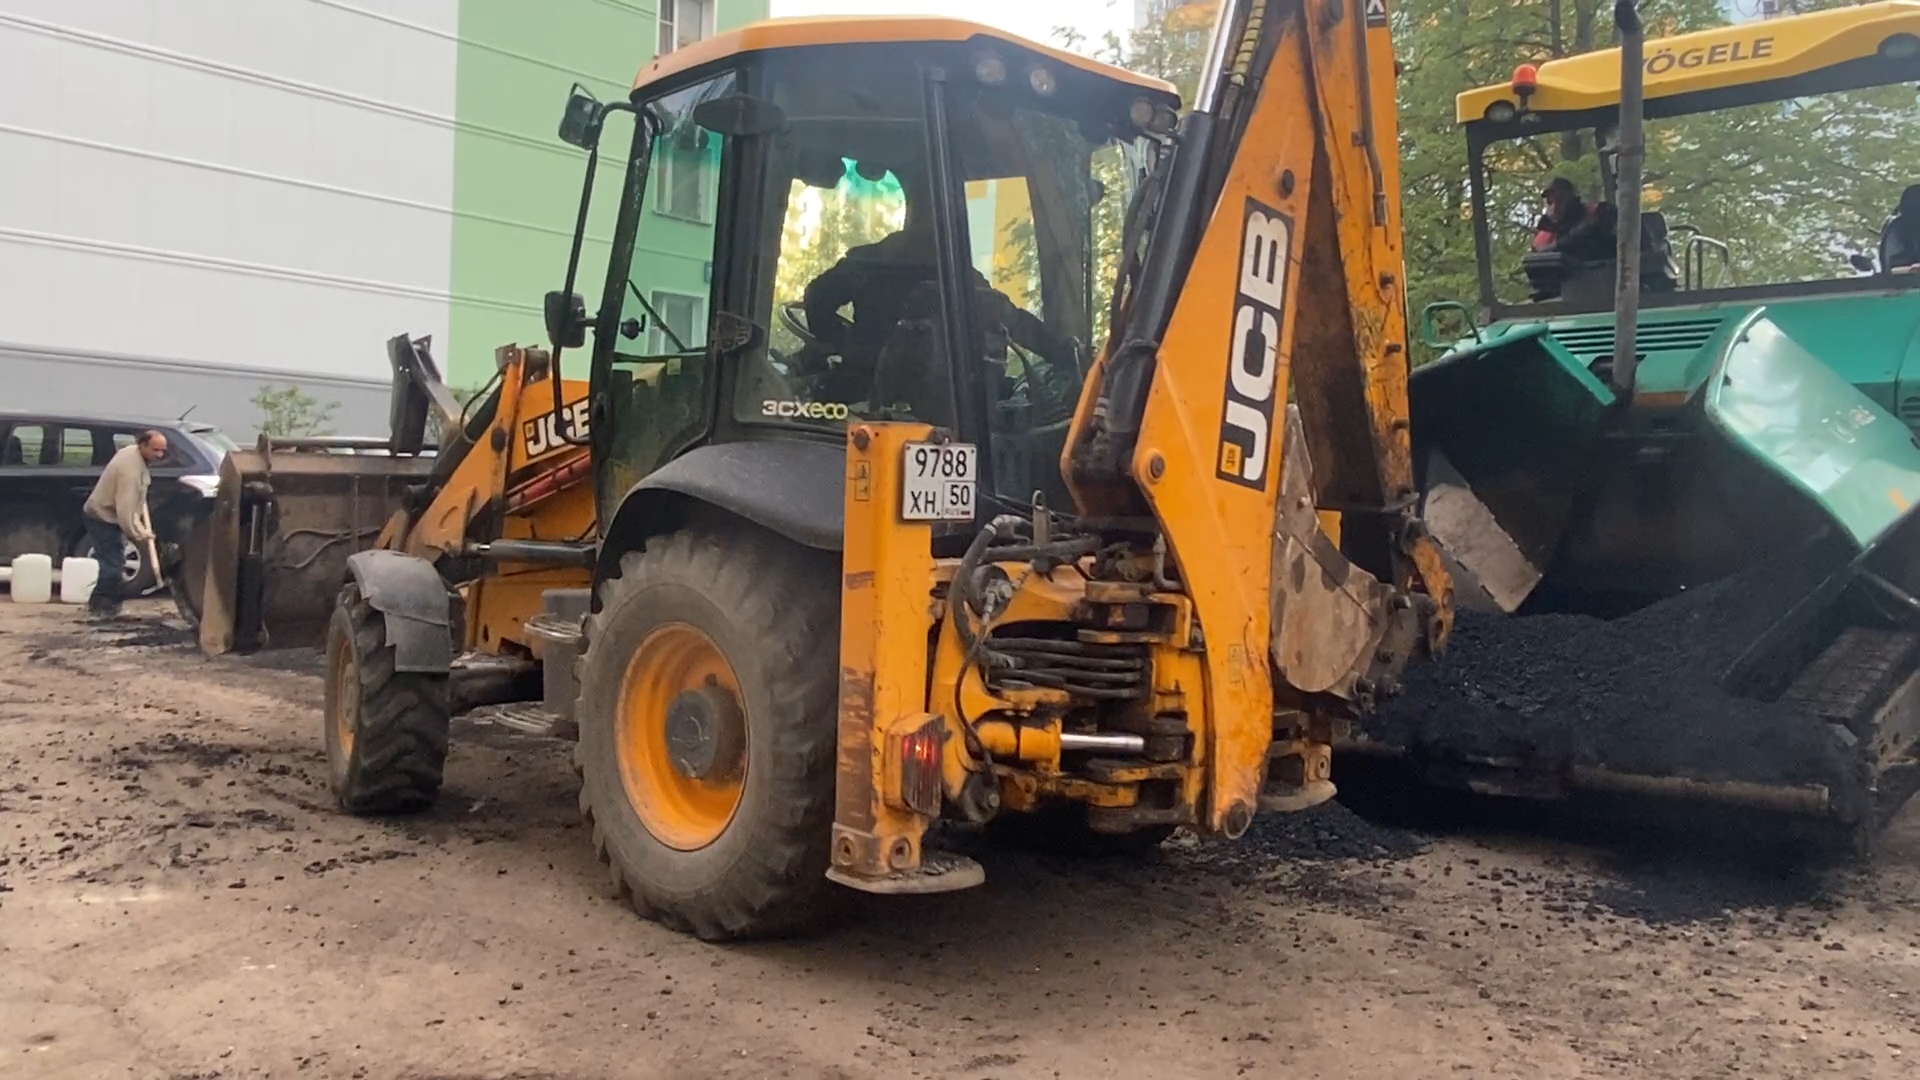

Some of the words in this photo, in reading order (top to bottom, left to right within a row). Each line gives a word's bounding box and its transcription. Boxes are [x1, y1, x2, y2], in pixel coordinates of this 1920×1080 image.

[1643, 37, 1774, 75] ÖGELE
[1225, 210, 1288, 481] JCB
[915, 448, 967, 477] 9788
[950, 484, 970, 506] 50
